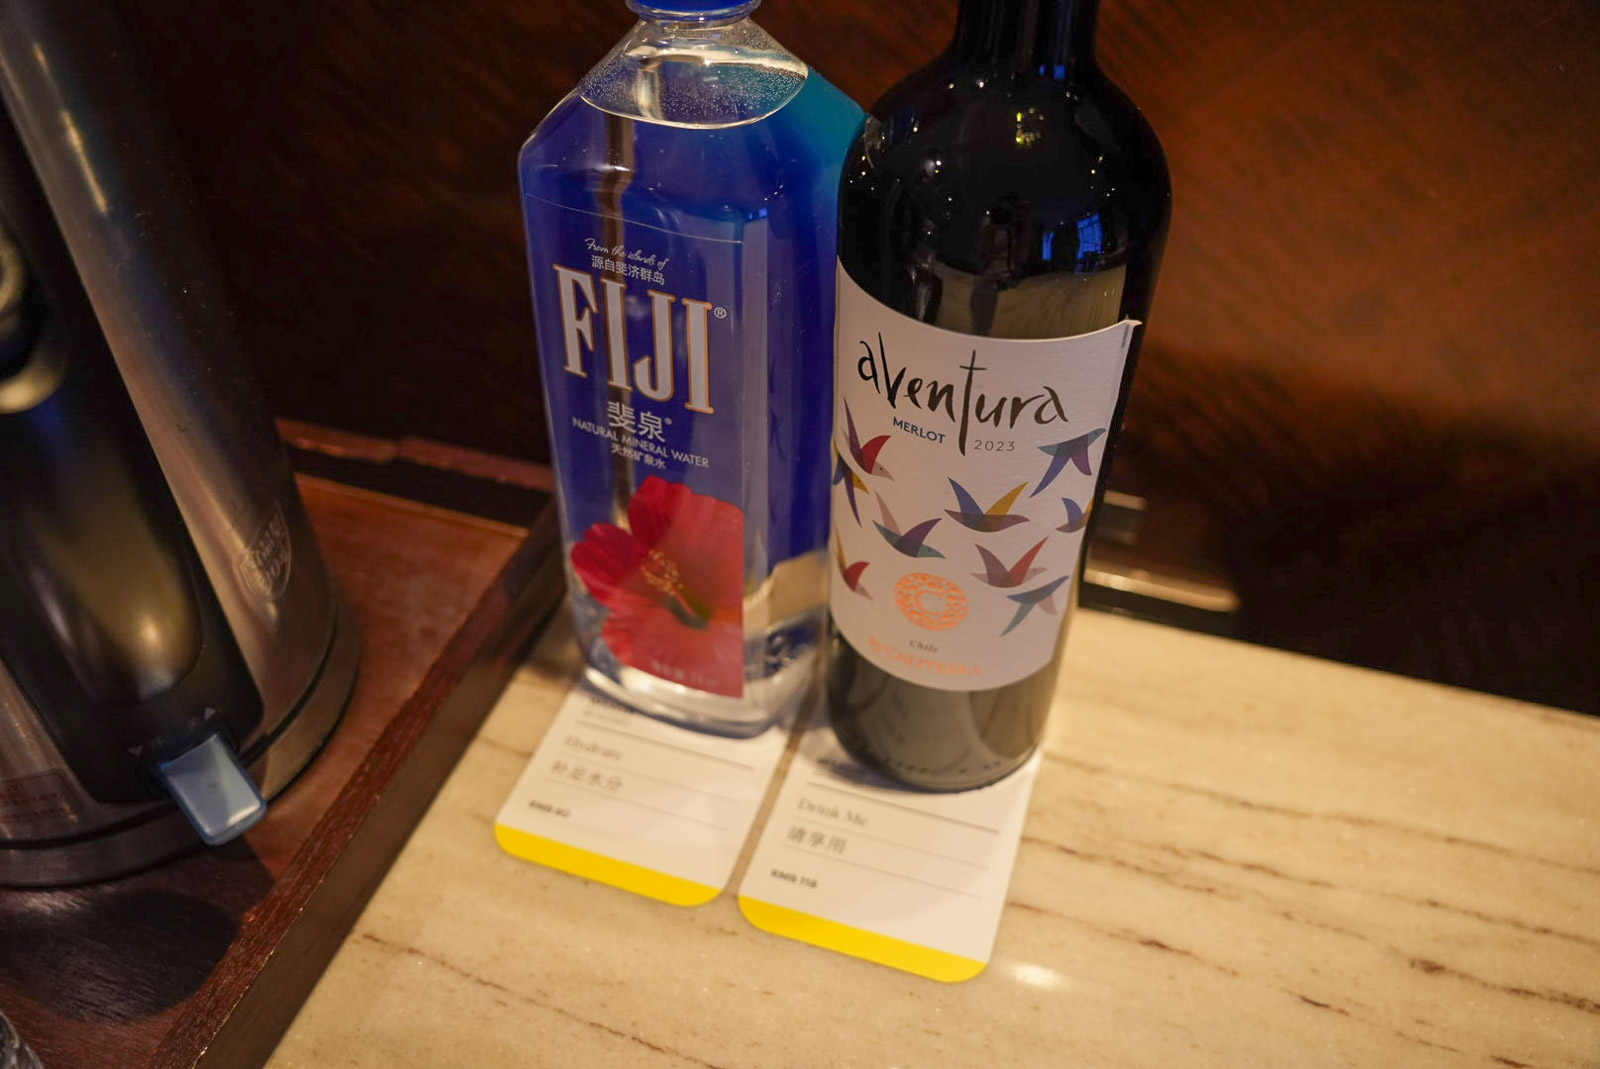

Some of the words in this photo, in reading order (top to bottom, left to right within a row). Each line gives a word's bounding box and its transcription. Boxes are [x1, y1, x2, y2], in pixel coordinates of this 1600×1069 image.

[584, 237, 609, 254] From
[611, 245, 627, 259] the
[627, 250, 656, 266] islands
[656, 258, 670, 271] of
[591, 254, 666, 286] 源自斐济群岛
[552, 263, 716, 414] FIJI
[572, 416, 619, 442] NATURAL
[622, 436, 669, 458] MINERAL
[671, 449, 711, 468] WATER
[893, 416, 946, 444] MERLOT
[973, 439, 1016, 452] 2023
